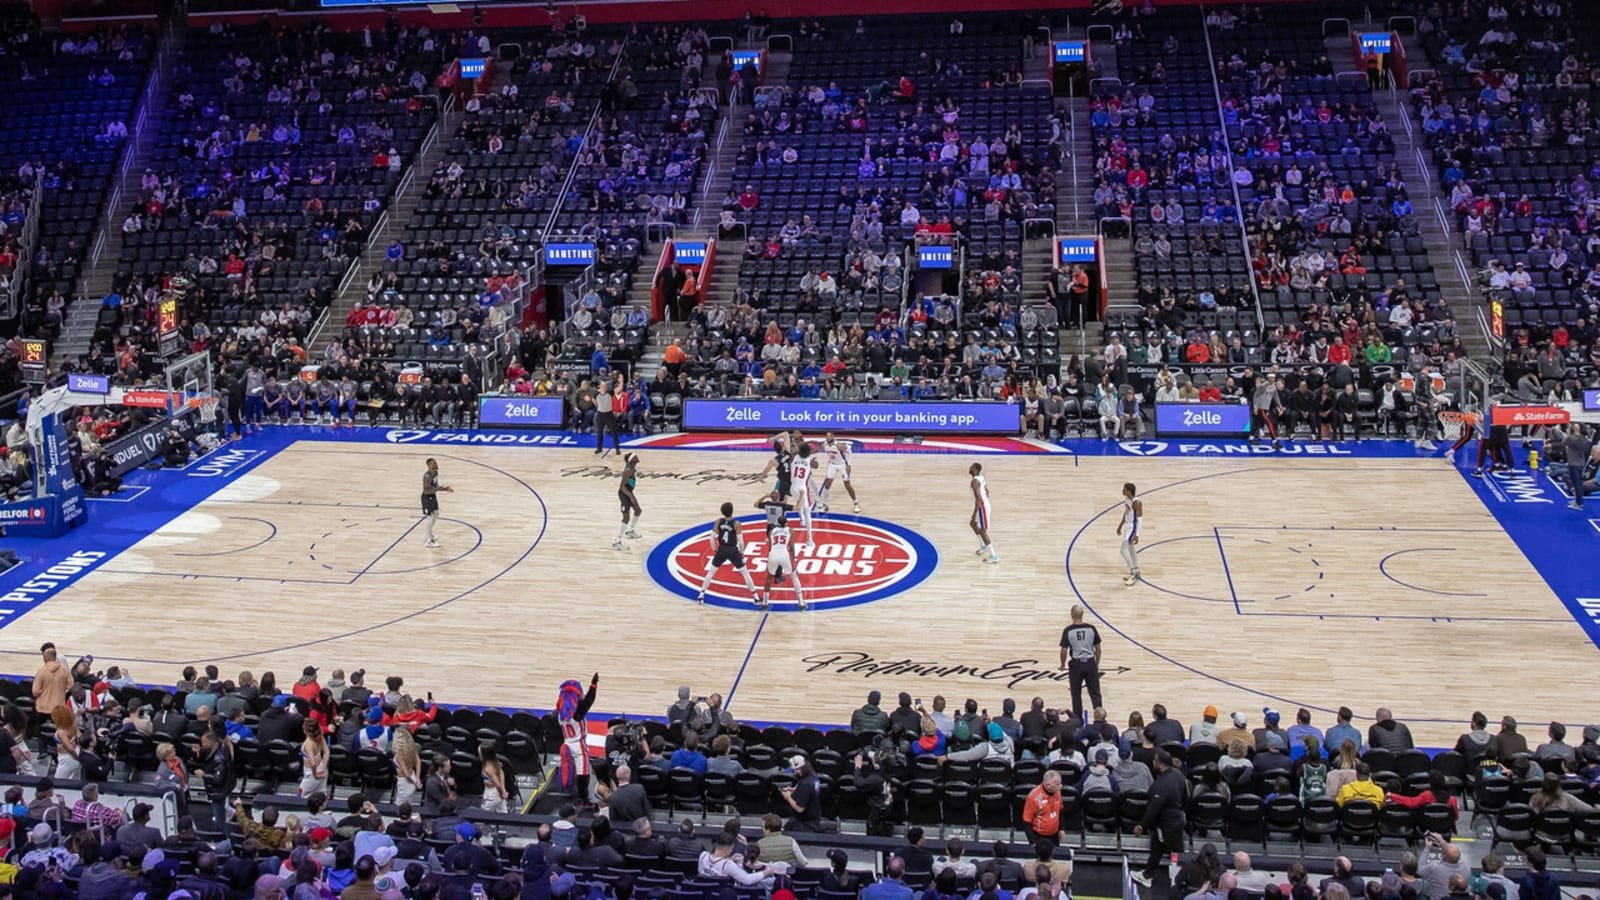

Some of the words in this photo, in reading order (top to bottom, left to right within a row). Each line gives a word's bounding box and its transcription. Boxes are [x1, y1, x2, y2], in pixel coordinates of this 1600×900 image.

[76, 378, 100, 389] Zelle
[504, 402, 539, 418] Zelle
[725, 406, 761, 422] Zelle
[781, 410, 811, 421] Look
[815, 411, 834, 422] for
[836, 411, 846, 422] it
[848, 411, 860, 422] in
[863, 414, 892, 425] your
[895, 412, 947, 425] banking
[950, 414, 979, 426] app.
[1183, 409, 1222, 426] Zelle
[430, 432, 578, 445] FANDUEL
[1179, 444, 1352, 455] FANDUEL
[187, 448, 257, 477] UWM
[793, 466, 806, 480] 13
[1491, 469, 1555, 505] UWM
[721, 531, 729, 544] 4
[772, 534, 787, 546] 35
[0, 550, 107, 603] PISTONS
[1076, 630, 1086, 641] 67
